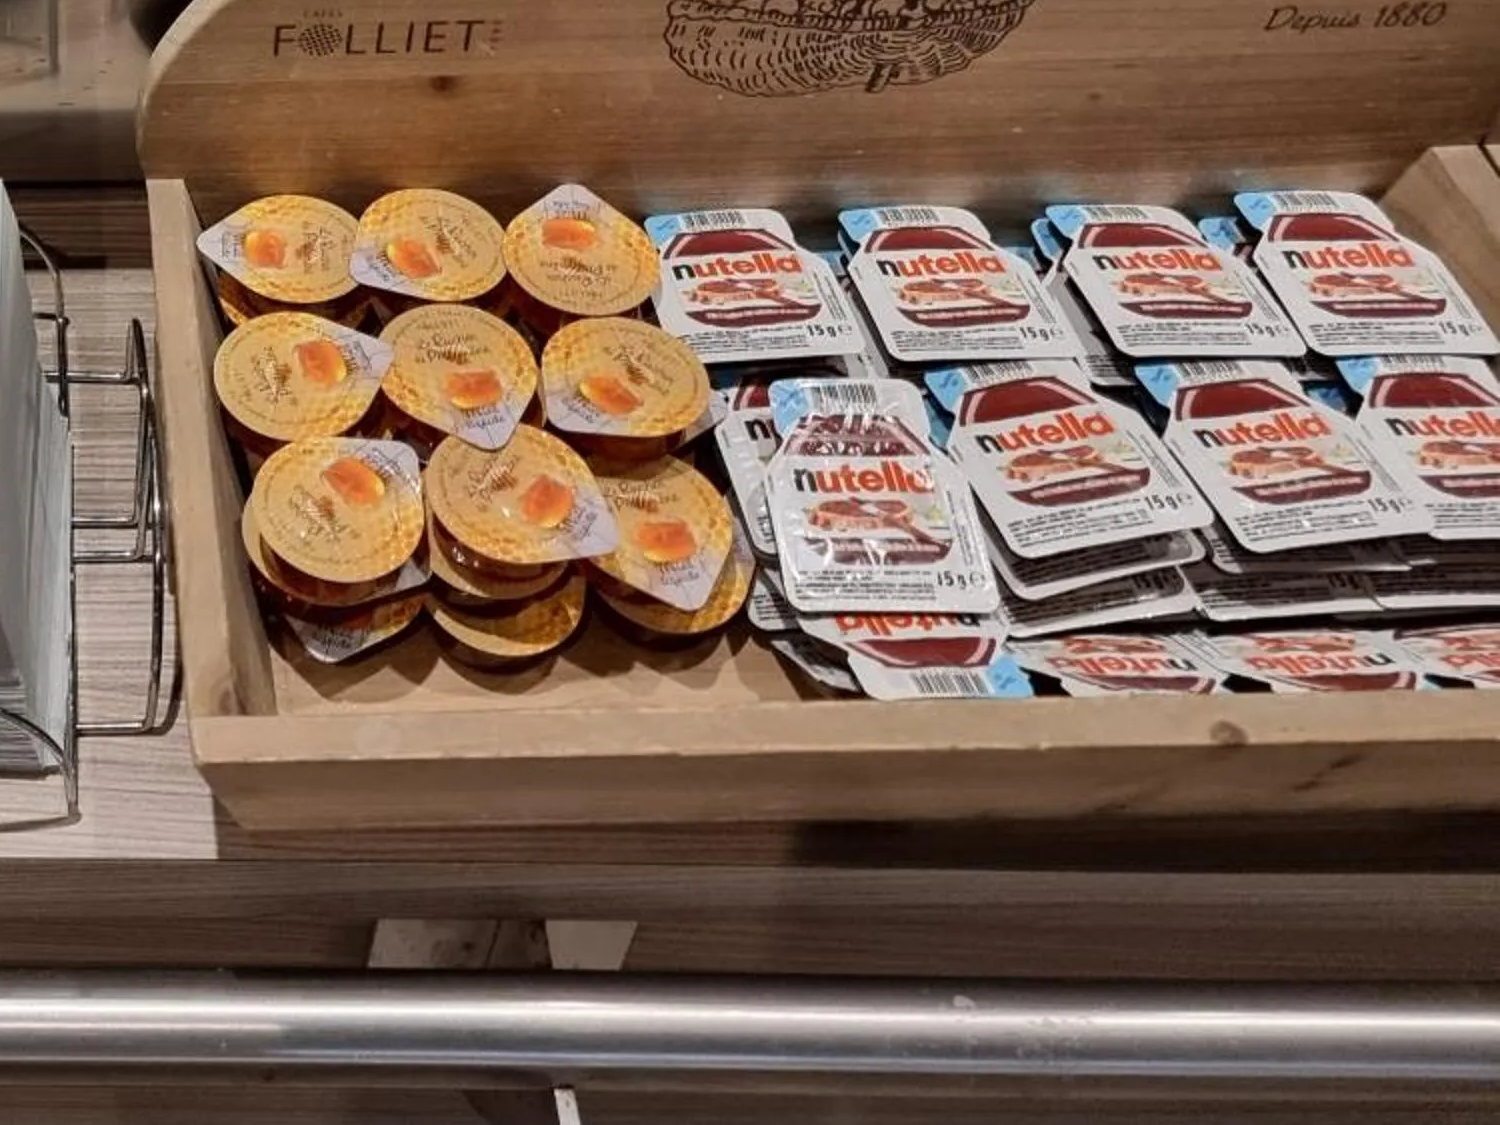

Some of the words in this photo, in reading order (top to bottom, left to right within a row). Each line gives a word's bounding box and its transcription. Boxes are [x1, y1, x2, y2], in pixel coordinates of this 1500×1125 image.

[1264, 5, 1361, 32] Depuis
[1373, 1, 1448, 28] 1880
[673, 253, 804, 282] nutella
[876, 252, 1007, 279] nutella
[1092, 245, 1223, 272] nutella
[1281, 244, 1415, 271] nutella
[977, 411, 1116, 455] nutella
[1193, 411, 1332, 448] nutella
[794, 462, 936, 495] nutella
[1046, 655, 1199, 674] nutella
[1245, 653, 1396, 675] nutella
